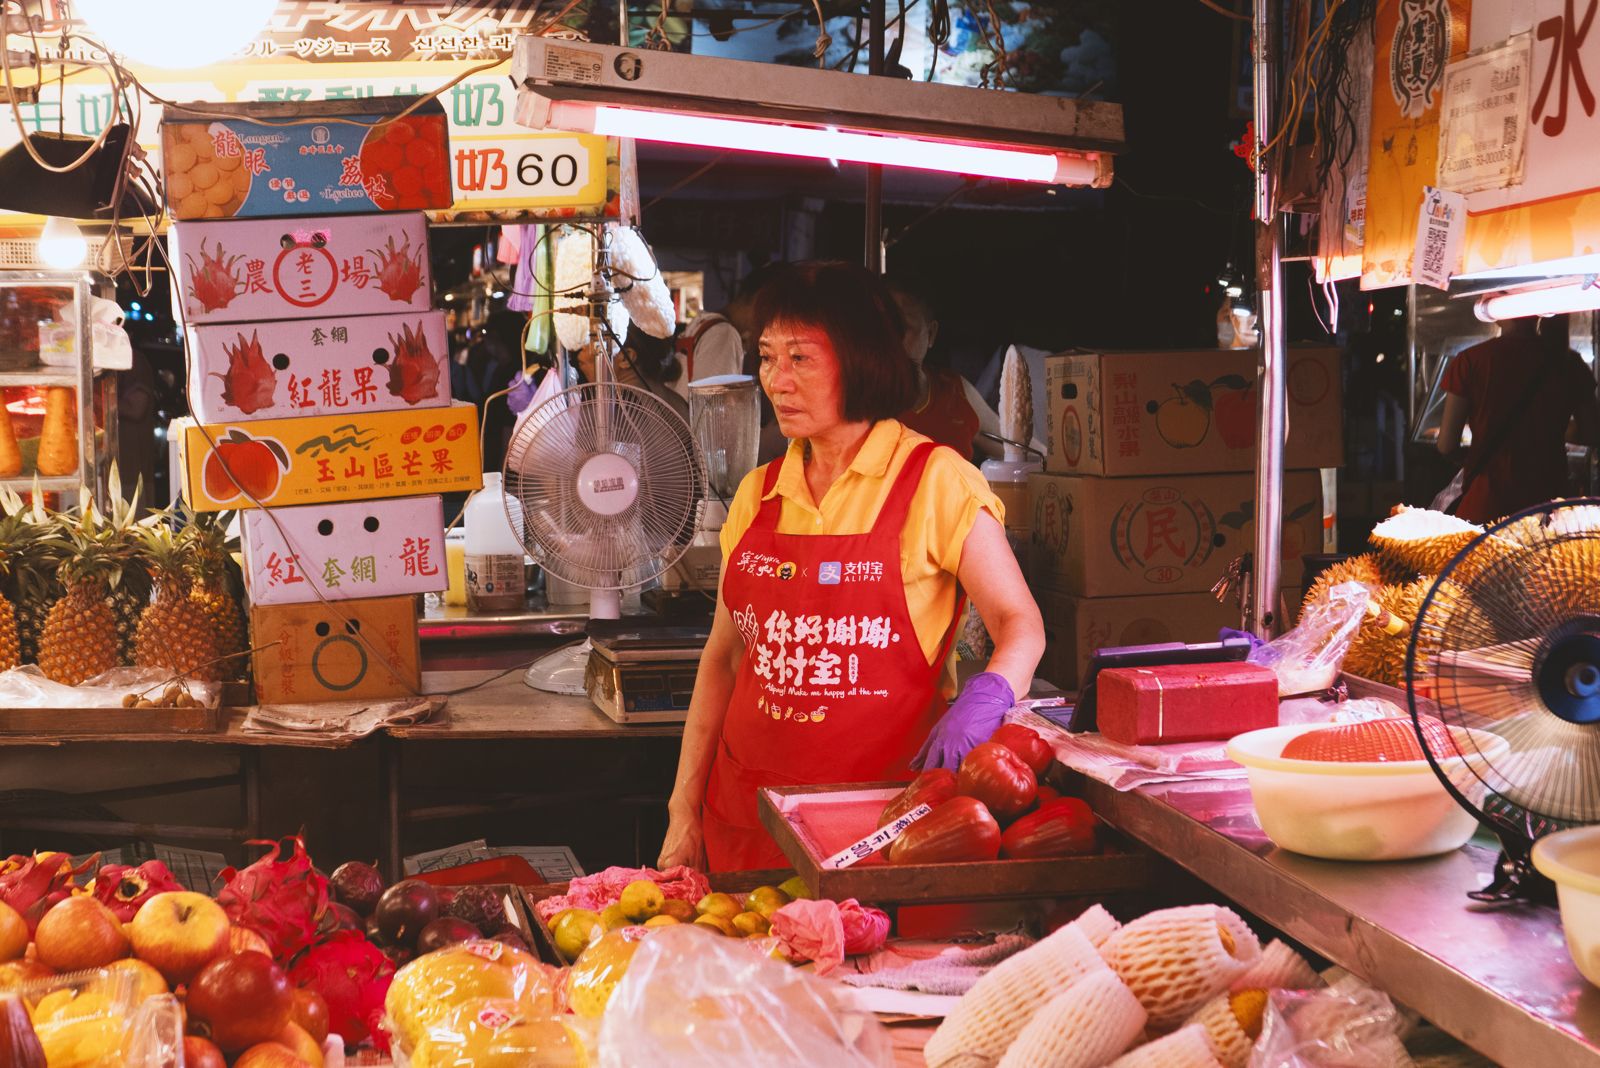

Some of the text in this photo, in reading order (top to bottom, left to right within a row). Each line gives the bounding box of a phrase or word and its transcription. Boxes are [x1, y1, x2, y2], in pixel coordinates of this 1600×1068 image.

[414, 36, 480, 50] 신선한
[1531, 0, 1598, 137] 水
[239, 133, 285, 145] Longan
[516, 153, 578, 187] 60
[287, 366, 378, 408] 紅龍果
[316, 448, 454, 483] 玉山區芒果
[1143, 506, 1187, 561] 民
[844, 561, 884, 575] 支付宝
[788, 687, 809, 697] Make
[810, 689, 822, 697] me
[824, 688, 845, 699] happy
[847, 687, 857, 696] all
[858, 688, 872, 696] the
